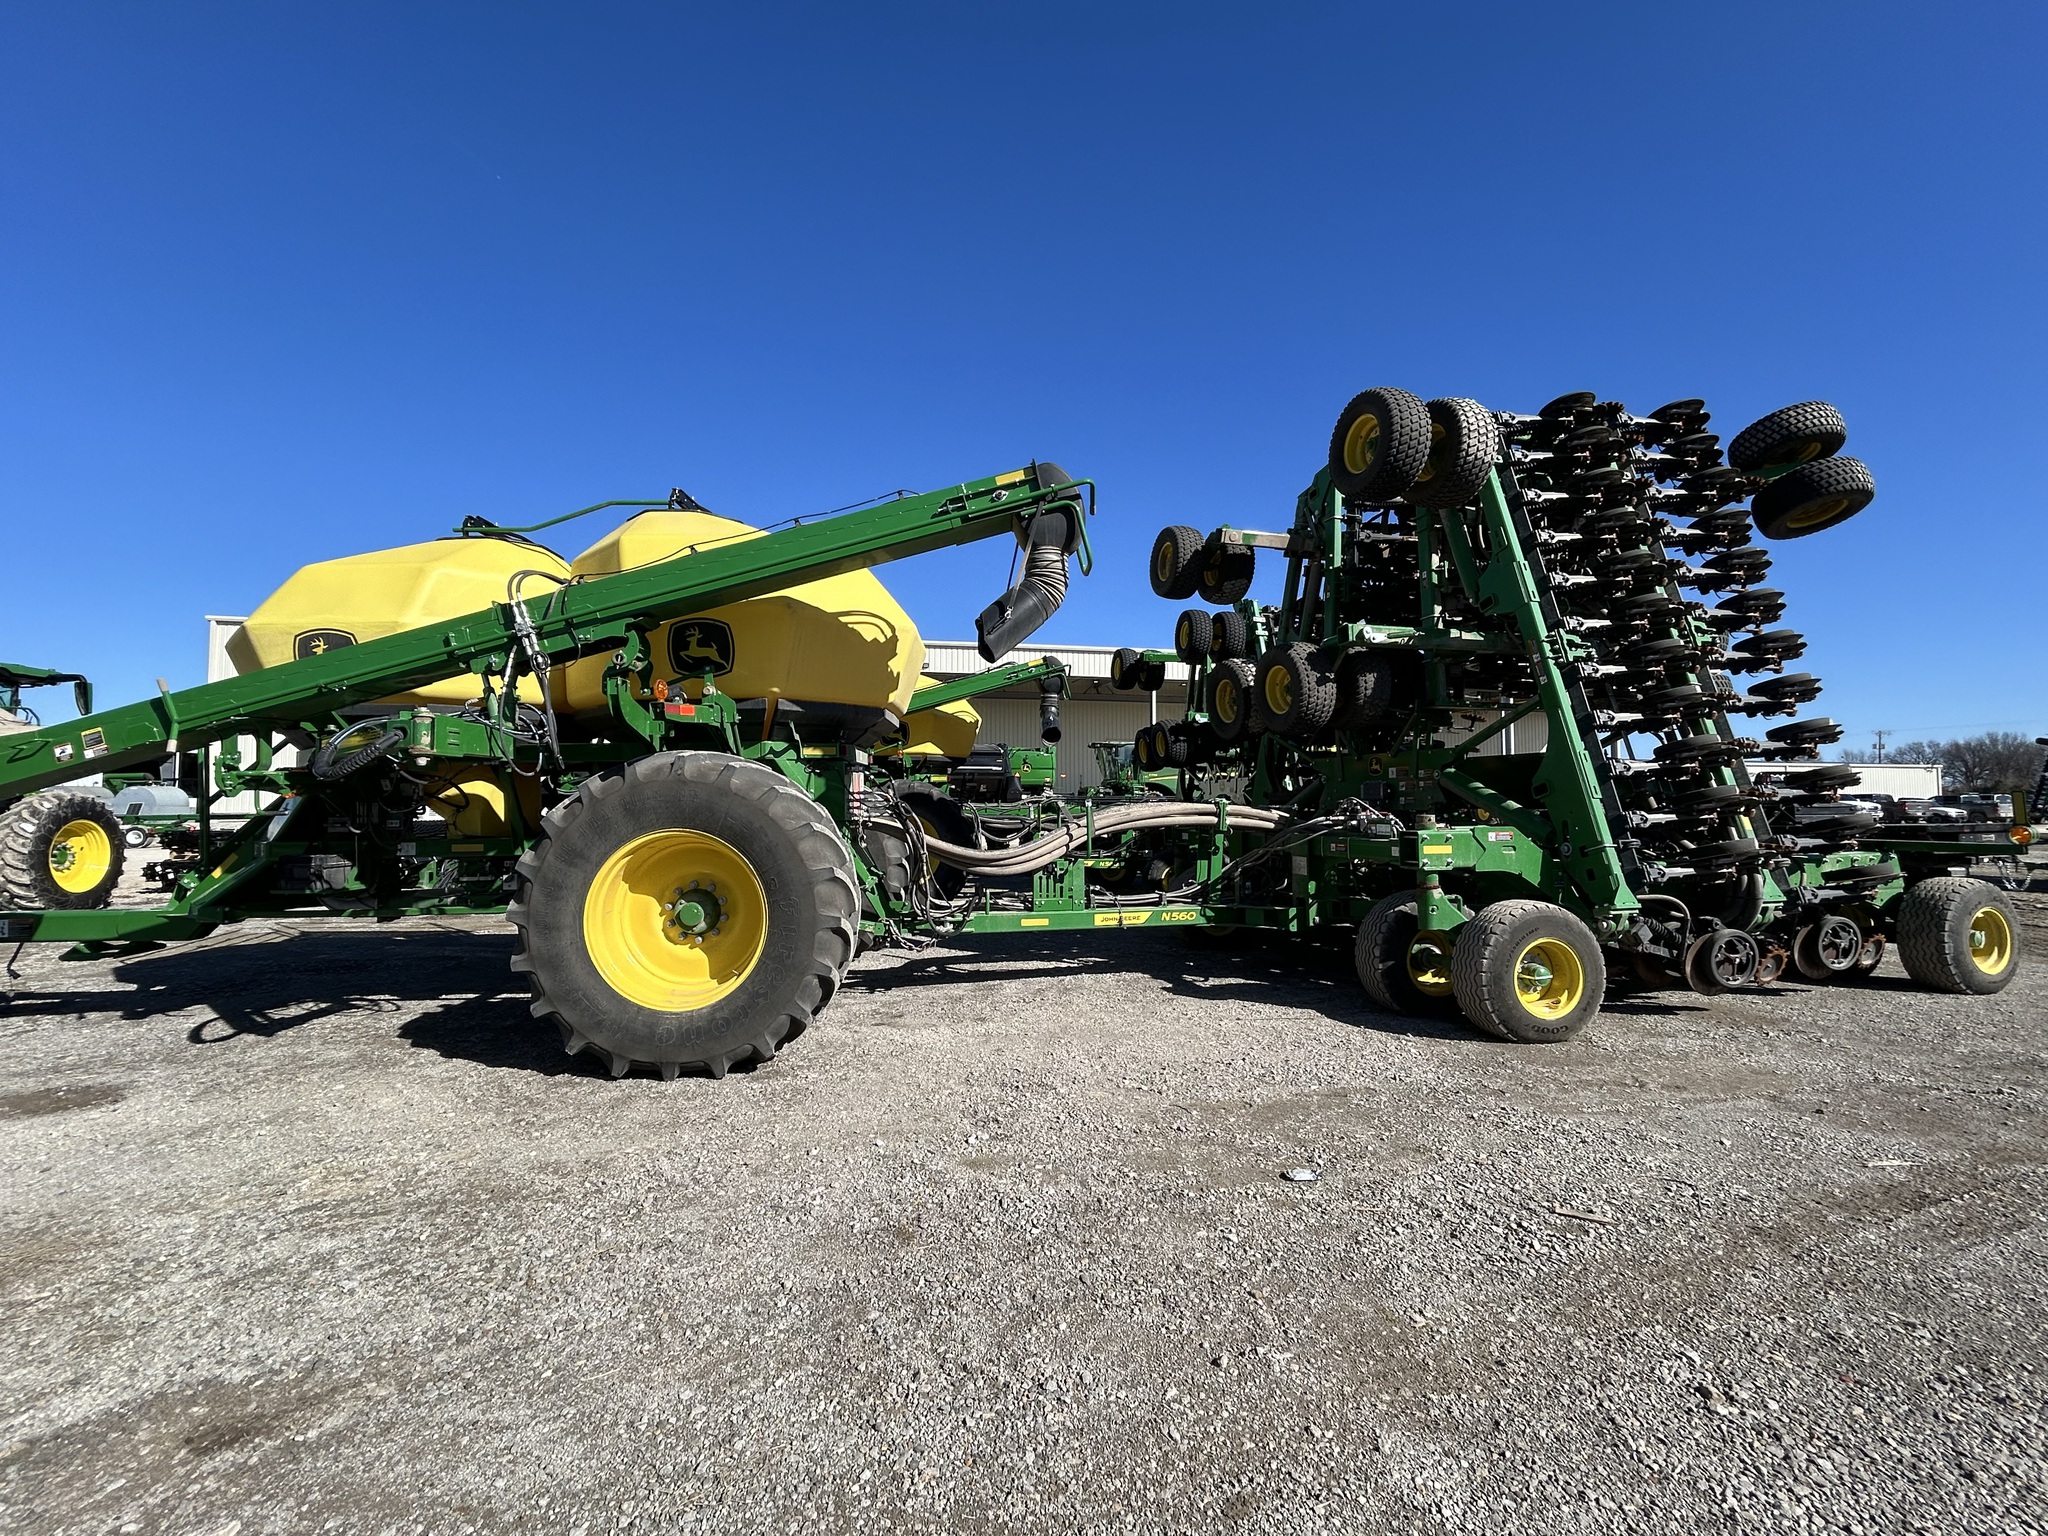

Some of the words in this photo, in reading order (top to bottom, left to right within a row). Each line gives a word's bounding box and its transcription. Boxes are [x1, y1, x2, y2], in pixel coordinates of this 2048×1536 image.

[576, 789, 663, 839] TRACTION
[1161, 911, 1197, 922] N560
[655, 896, 800, 1047] Firestone
